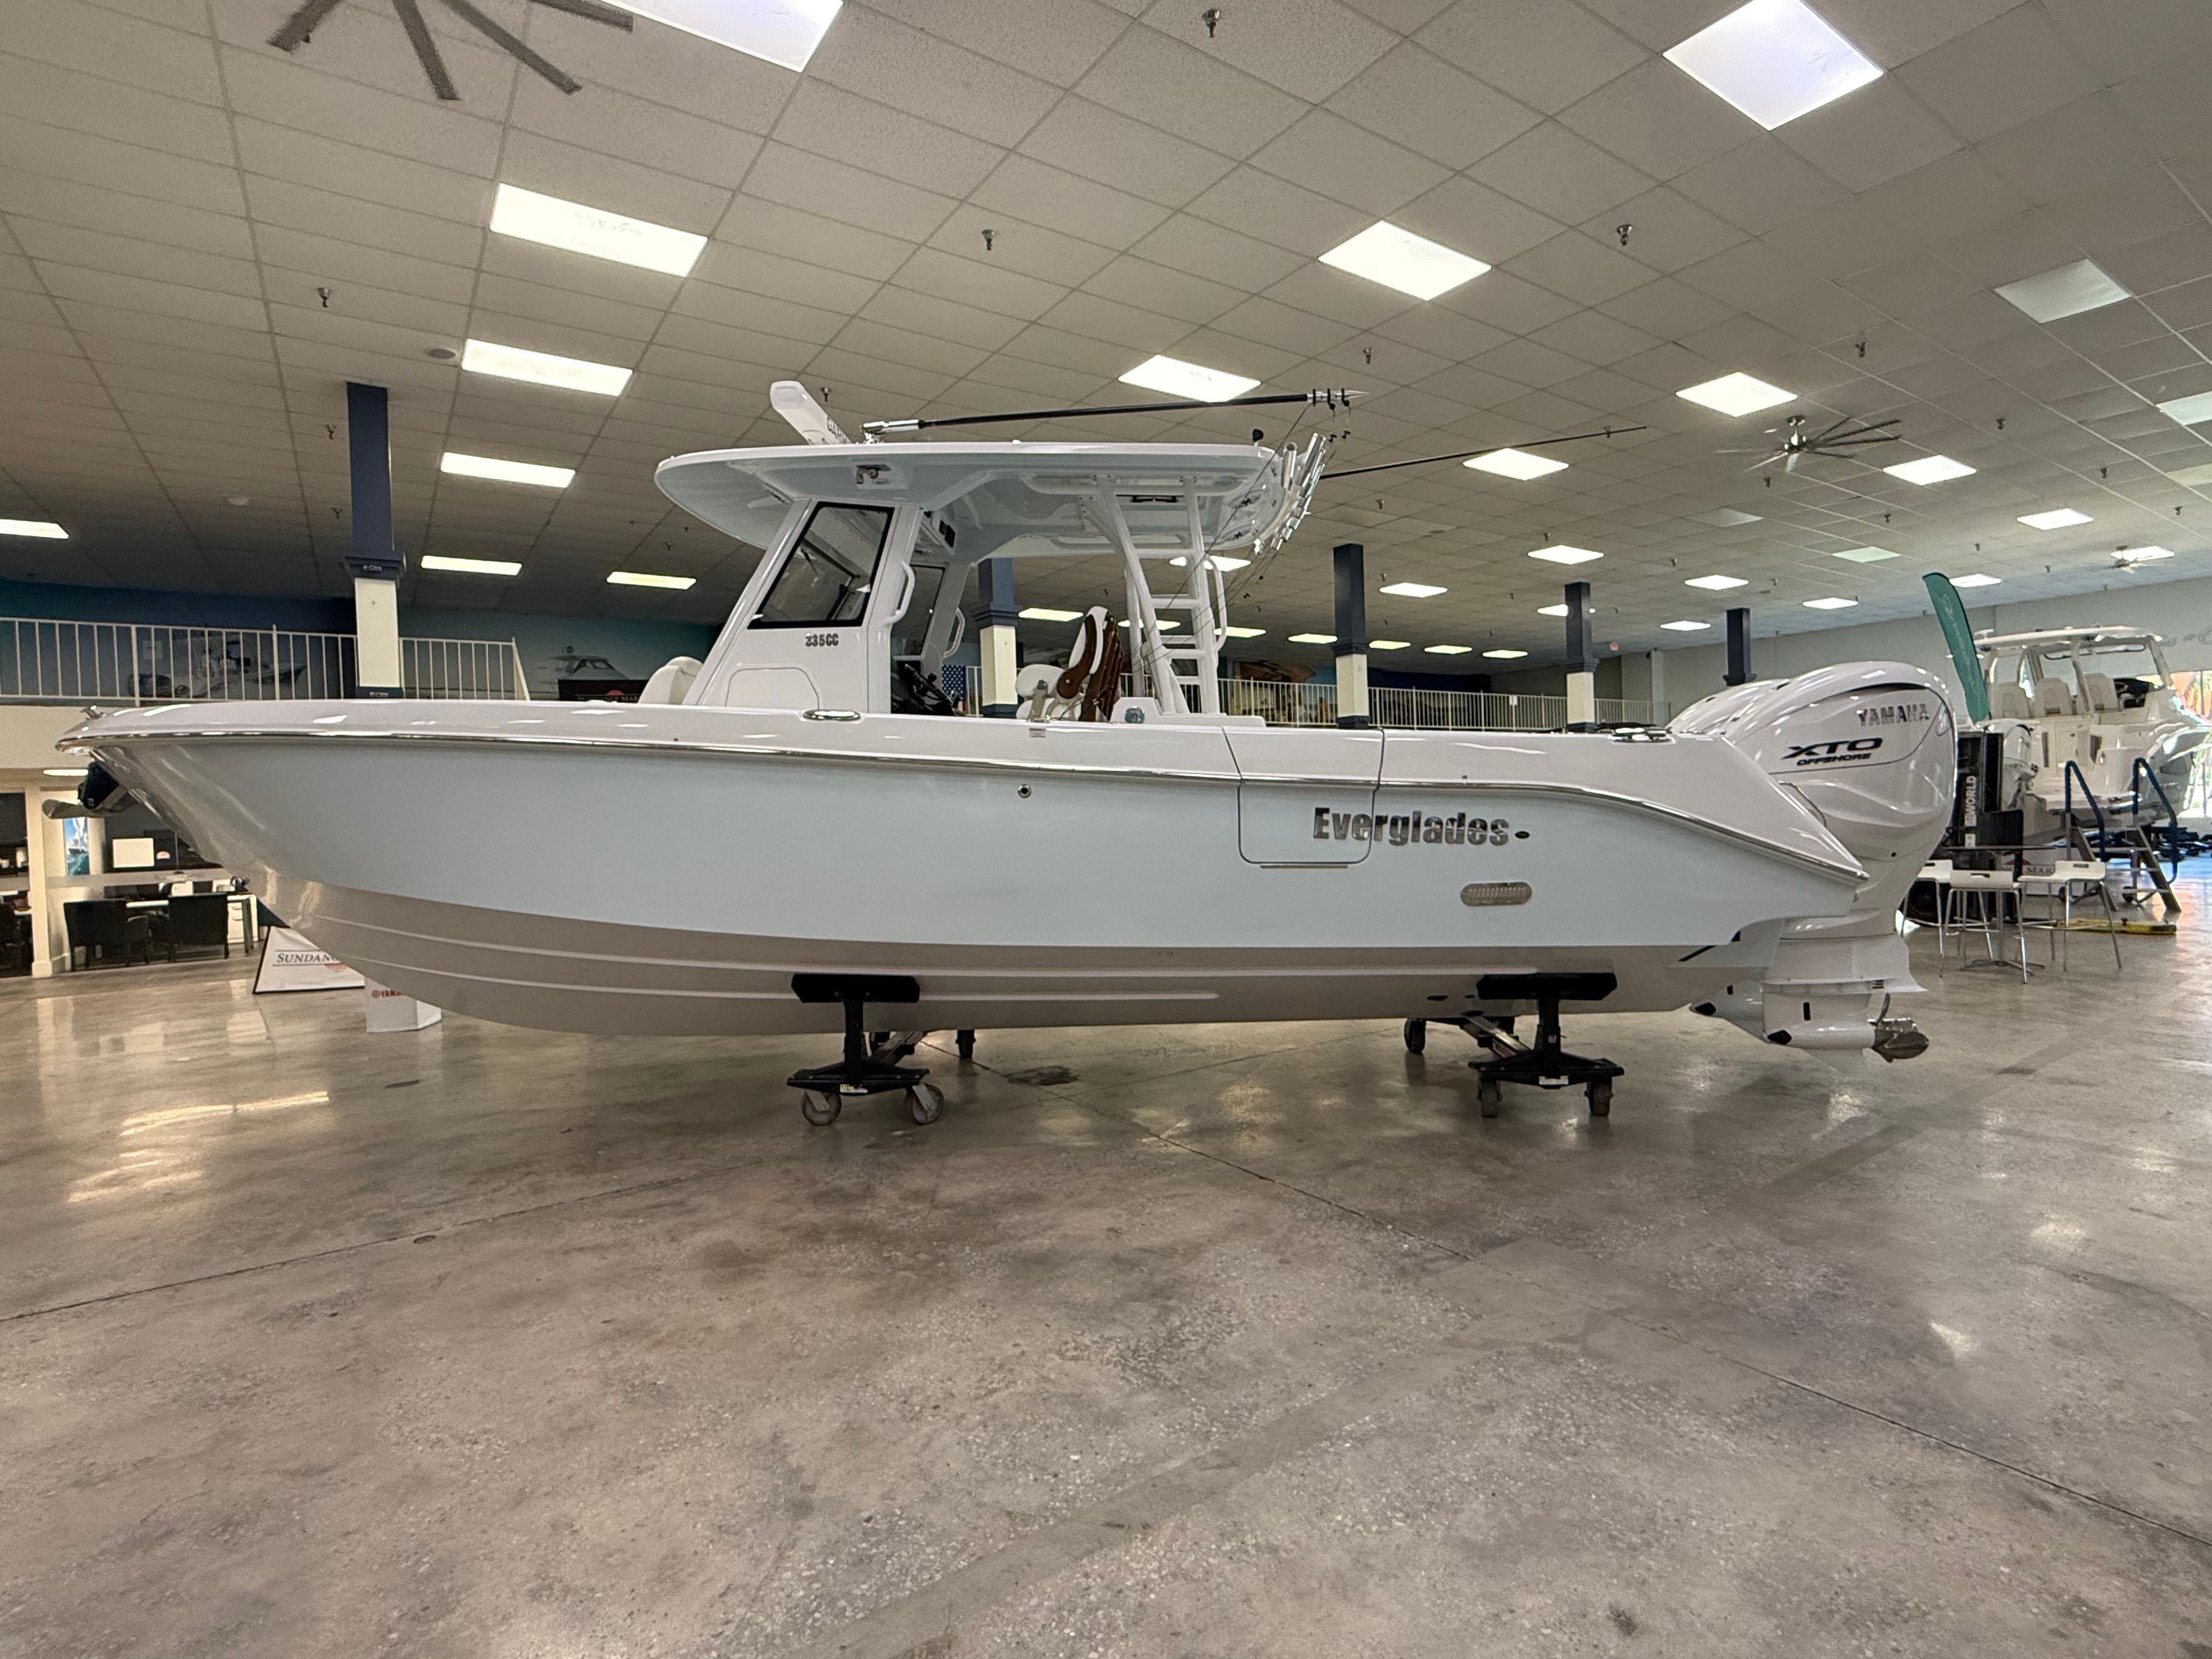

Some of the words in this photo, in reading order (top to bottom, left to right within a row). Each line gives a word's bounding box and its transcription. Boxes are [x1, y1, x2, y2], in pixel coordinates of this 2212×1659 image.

[1857, 703, 1929, 726] YAMAHA
[1782, 737, 1883, 760] XTO
[1796, 753, 1872, 766] OFFSHORE
[1313, 807, 1510, 845] Everglades
[276, 953, 336, 963] SUNDAN
